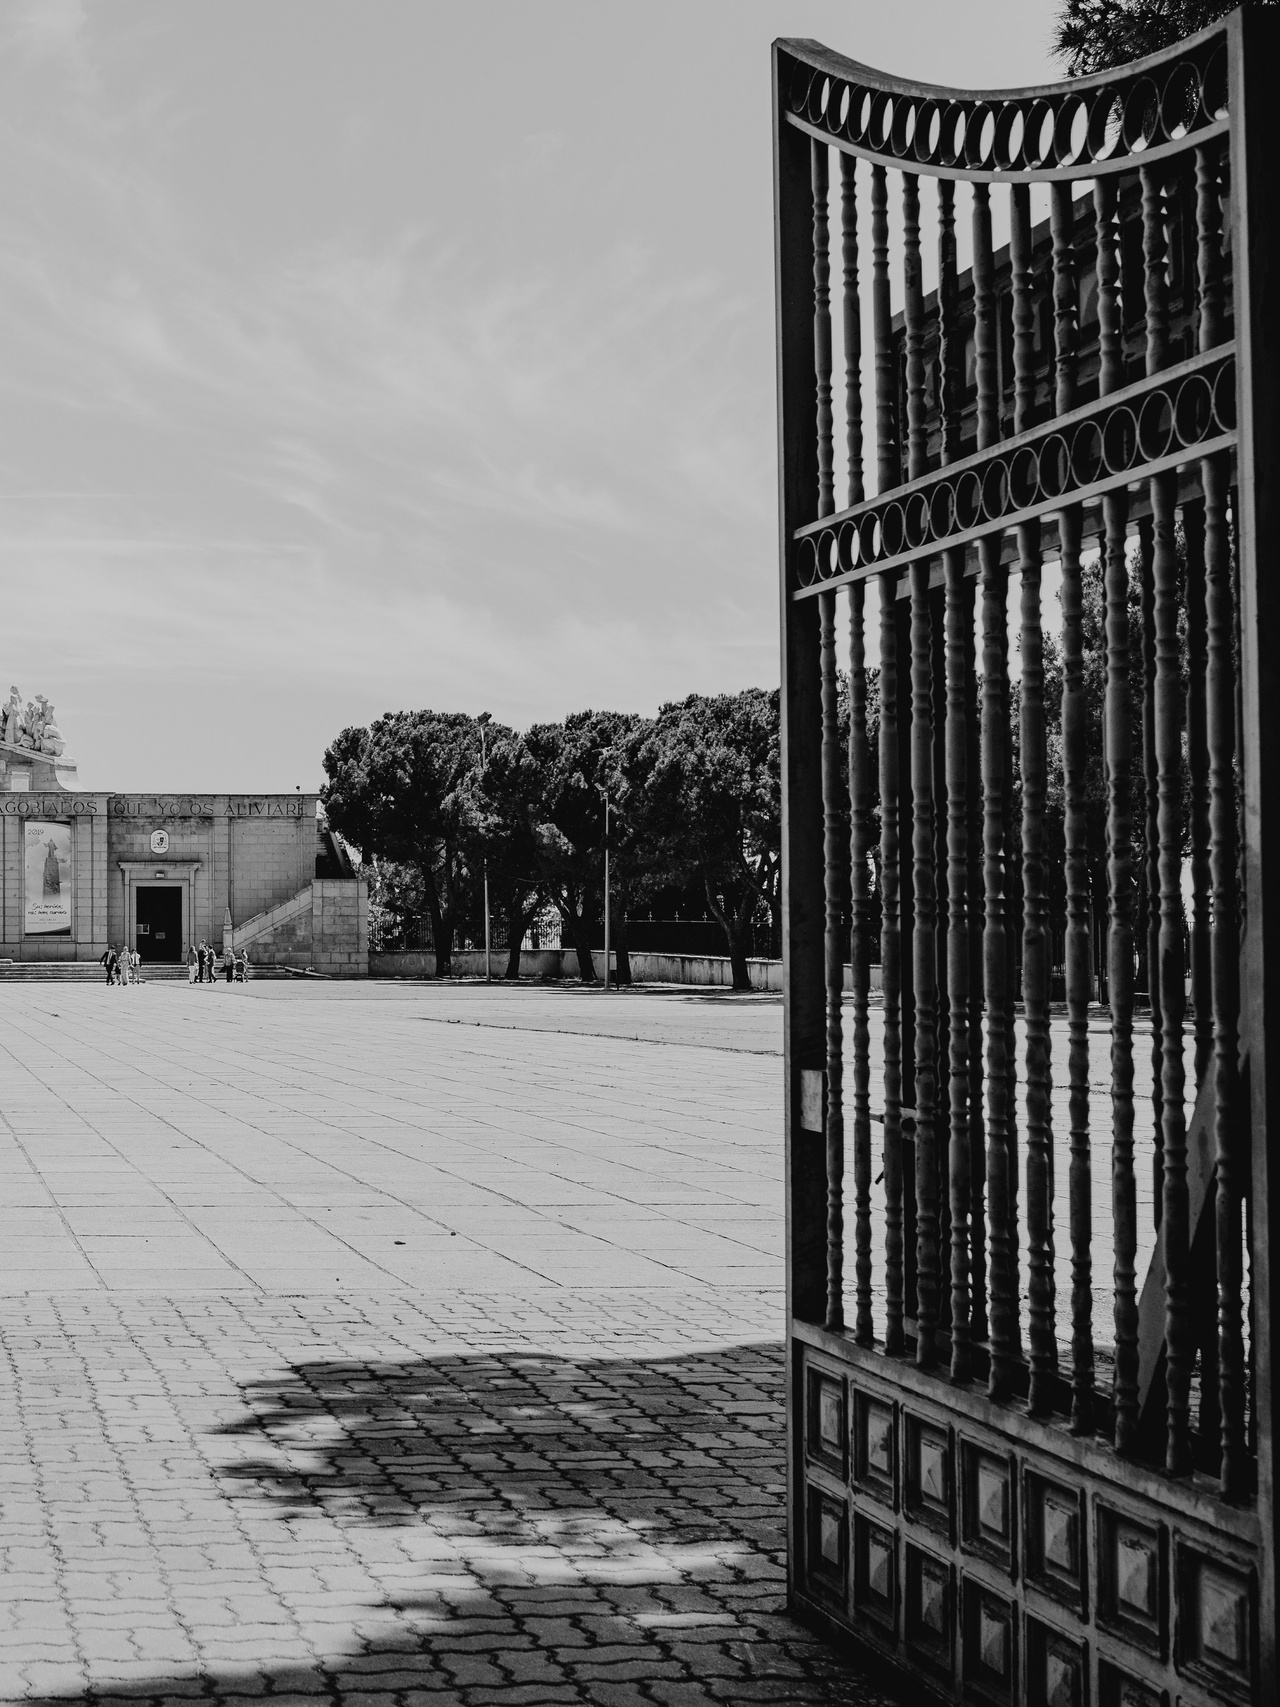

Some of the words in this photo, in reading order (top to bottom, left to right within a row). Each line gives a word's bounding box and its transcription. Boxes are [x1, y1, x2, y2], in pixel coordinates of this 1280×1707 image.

[113, 802, 148, 816] QUE
[157, 802, 182, 816] YO
[189, 802, 214, 816] OS
[223, 802, 308, 816] ALIVIARE
[27, 828, 44, 836] 2019
